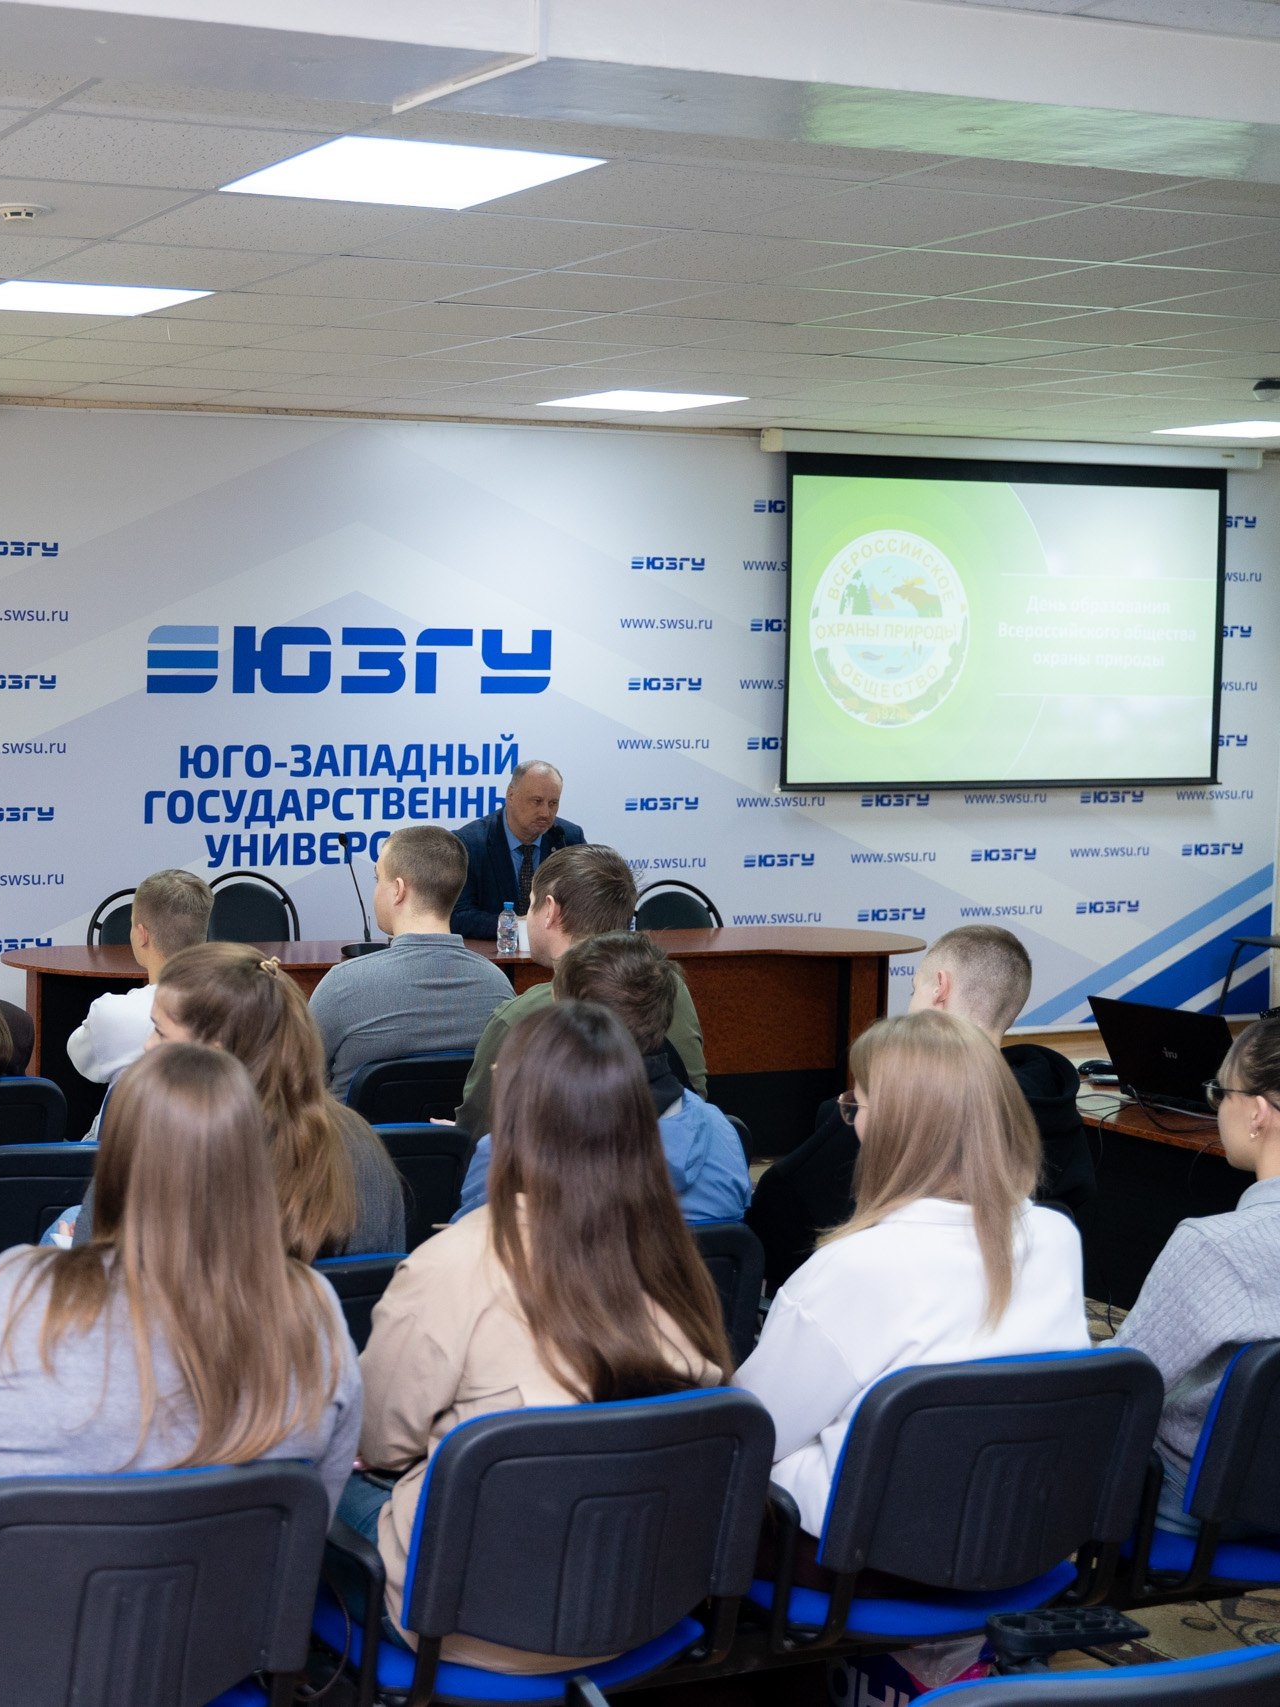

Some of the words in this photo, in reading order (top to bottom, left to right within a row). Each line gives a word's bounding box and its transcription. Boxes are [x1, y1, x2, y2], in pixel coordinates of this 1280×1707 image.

[1225, 516, 1257, 528] ЗГУ
[646, 557, 705, 571] ЮЗГУ
[619, 618, 713, 631] www.swsu.ru
[815, 622, 879, 639] ОХРАНЫ
[1222, 626, 1252, 638] ЗГУ
[232, 625, 552, 694] ЮЗГУ
[643, 677, 702, 691] ЮЗГУ
[616, 738, 710, 750] www.swsu.ru
[1218, 734, 1248, 747] ЗГУ
[179, 734, 519, 782] ЮГО-ЗАПАДНЫЙ
[736, 794, 826, 808] www.swsu.ru
[873, 793, 930, 808] ЮЗГУ
[964, 791, 1047, 805] www.swsu.ru
[1093, 790, 1144, 804] ЮЗГУ
[1176, 788, 1254, 801] www.swsu.ru
[144, 786, 505, 829] ГОСУДАРСТВЕНН
[639, 796, 699, 811] ЮЗГУ
[984, 847, 1037, 861] ЮЗГУ
[1070, 844, 1150, 858] www.swsu.ru
[1194, 843, 1244, 856] ЮЗГУ
[625, 856, 707, 869] ww.swsu.ru
[758, 853, 815, 868] ЮЗГУ
[850, 850, 936, 864] www.swsu.ru
[960, 903, 1043, 918] www.swsu.ru
[1088, 900, 1140, 914] ЮЗГУ
[732, 911, 822, 925] www.swsu.ru
[870, 907, 926, 922] ЮЗГУ
